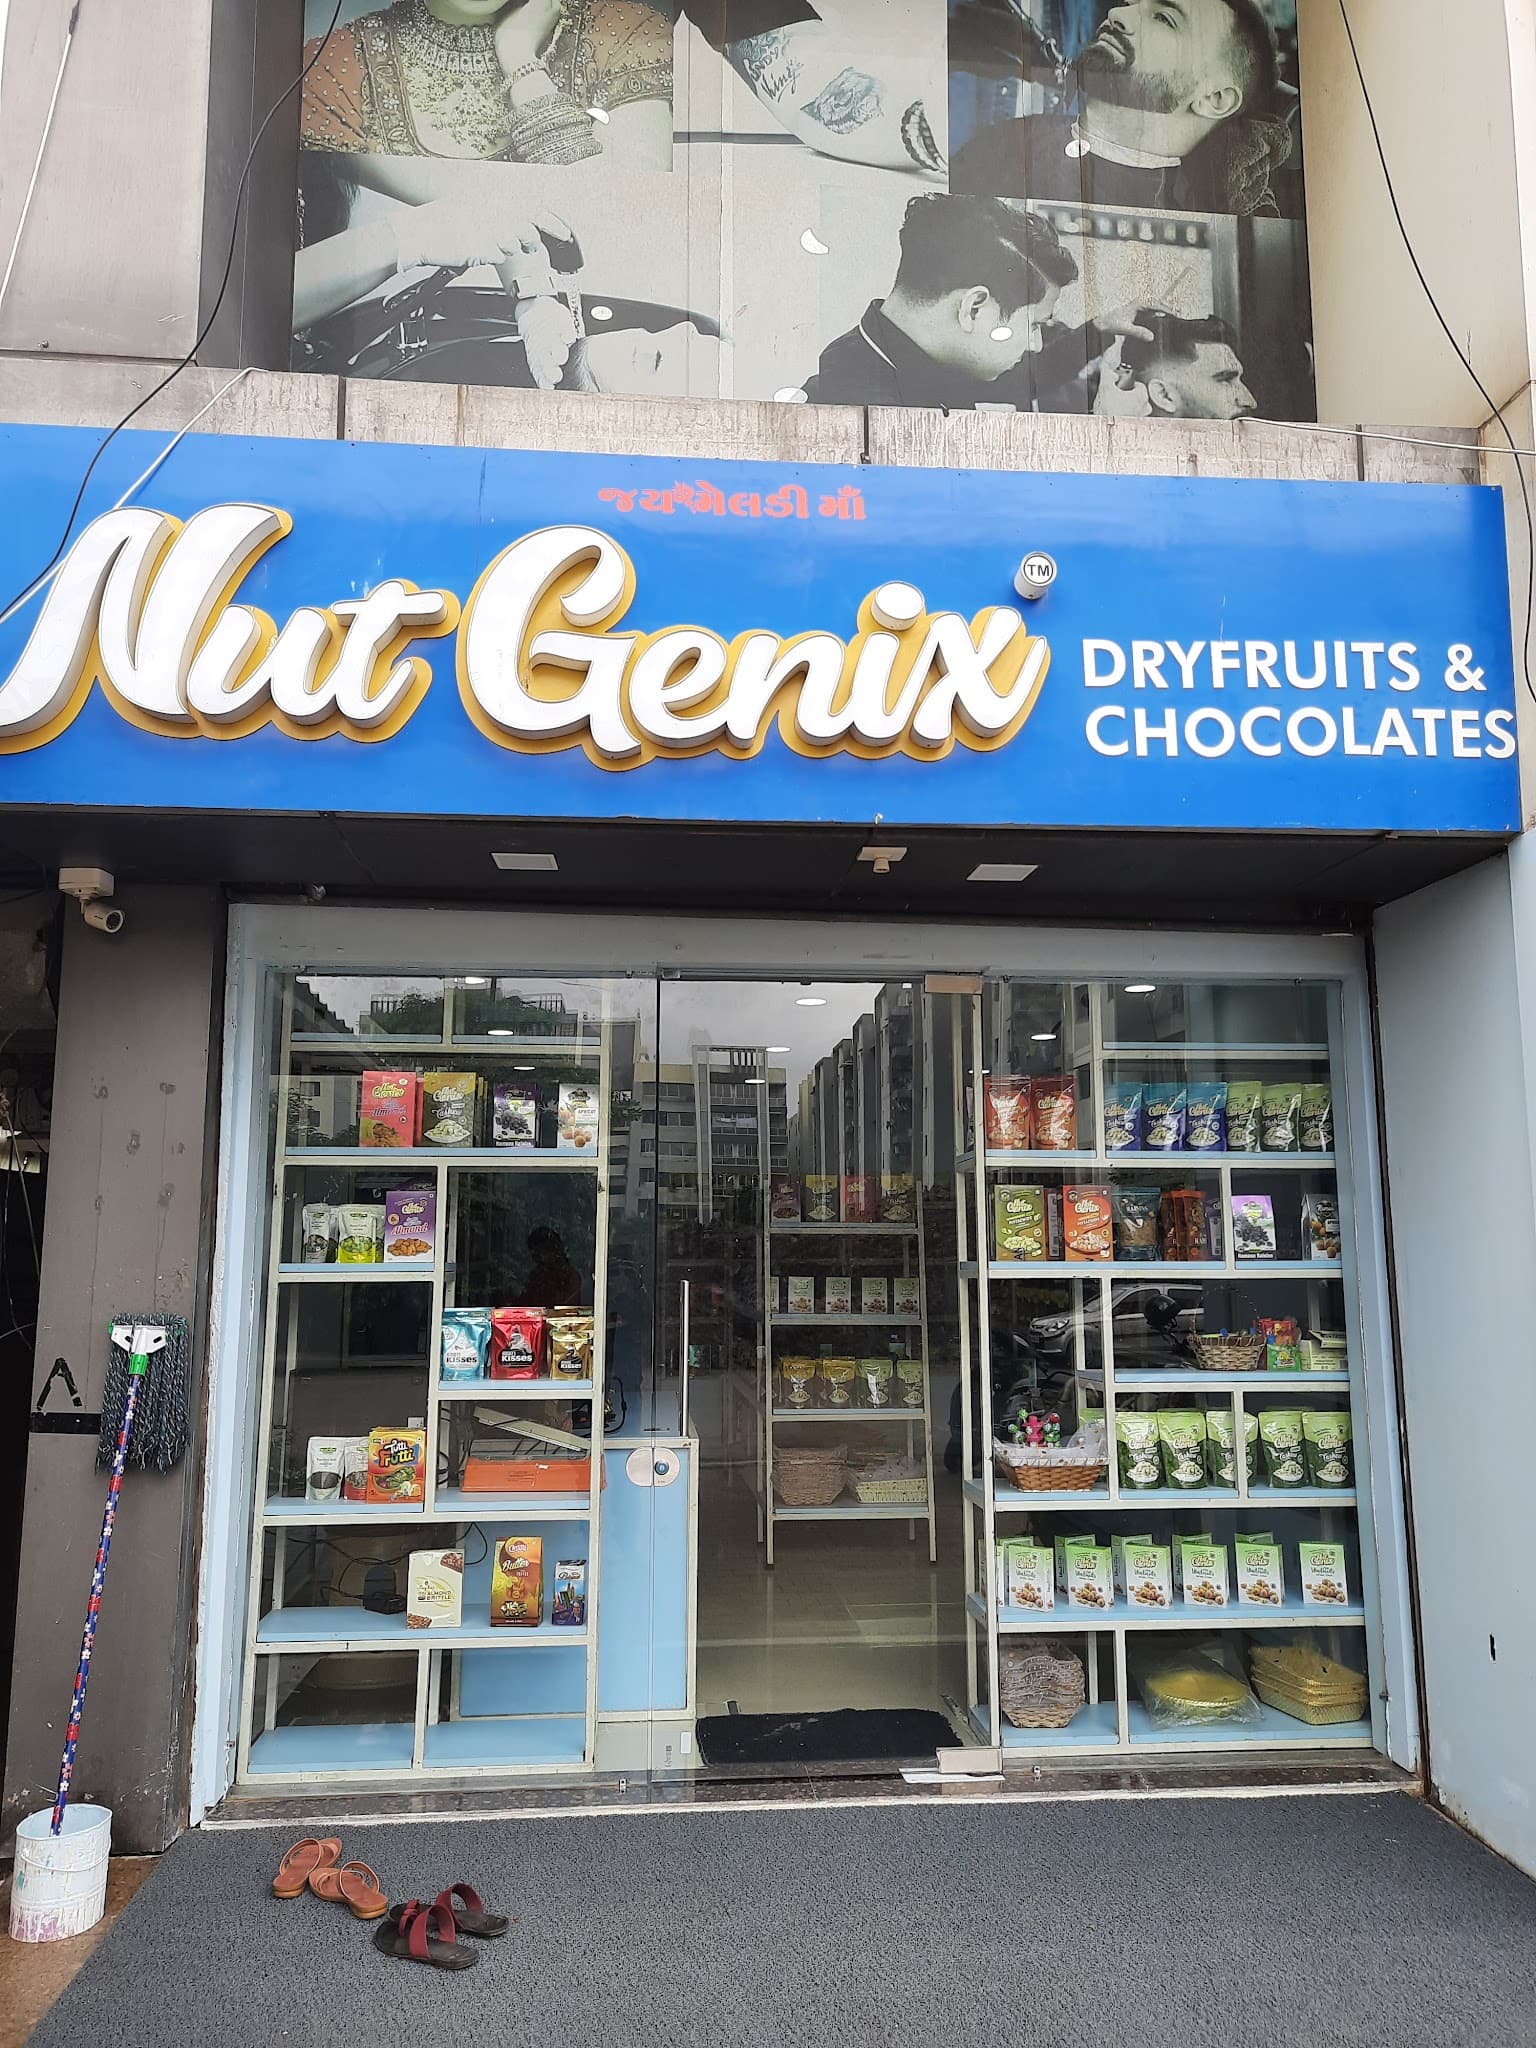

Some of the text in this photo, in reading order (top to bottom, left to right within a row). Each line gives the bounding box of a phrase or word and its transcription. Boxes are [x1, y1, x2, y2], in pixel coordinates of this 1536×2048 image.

[1027, 564, 1050, 576] TM
[0, 503, 1048, 765] Nut Genix
[1081, 640, 1486, 691] DRYFRUITS &
[1086, 707, 1516, 758] CHOCOLATES
